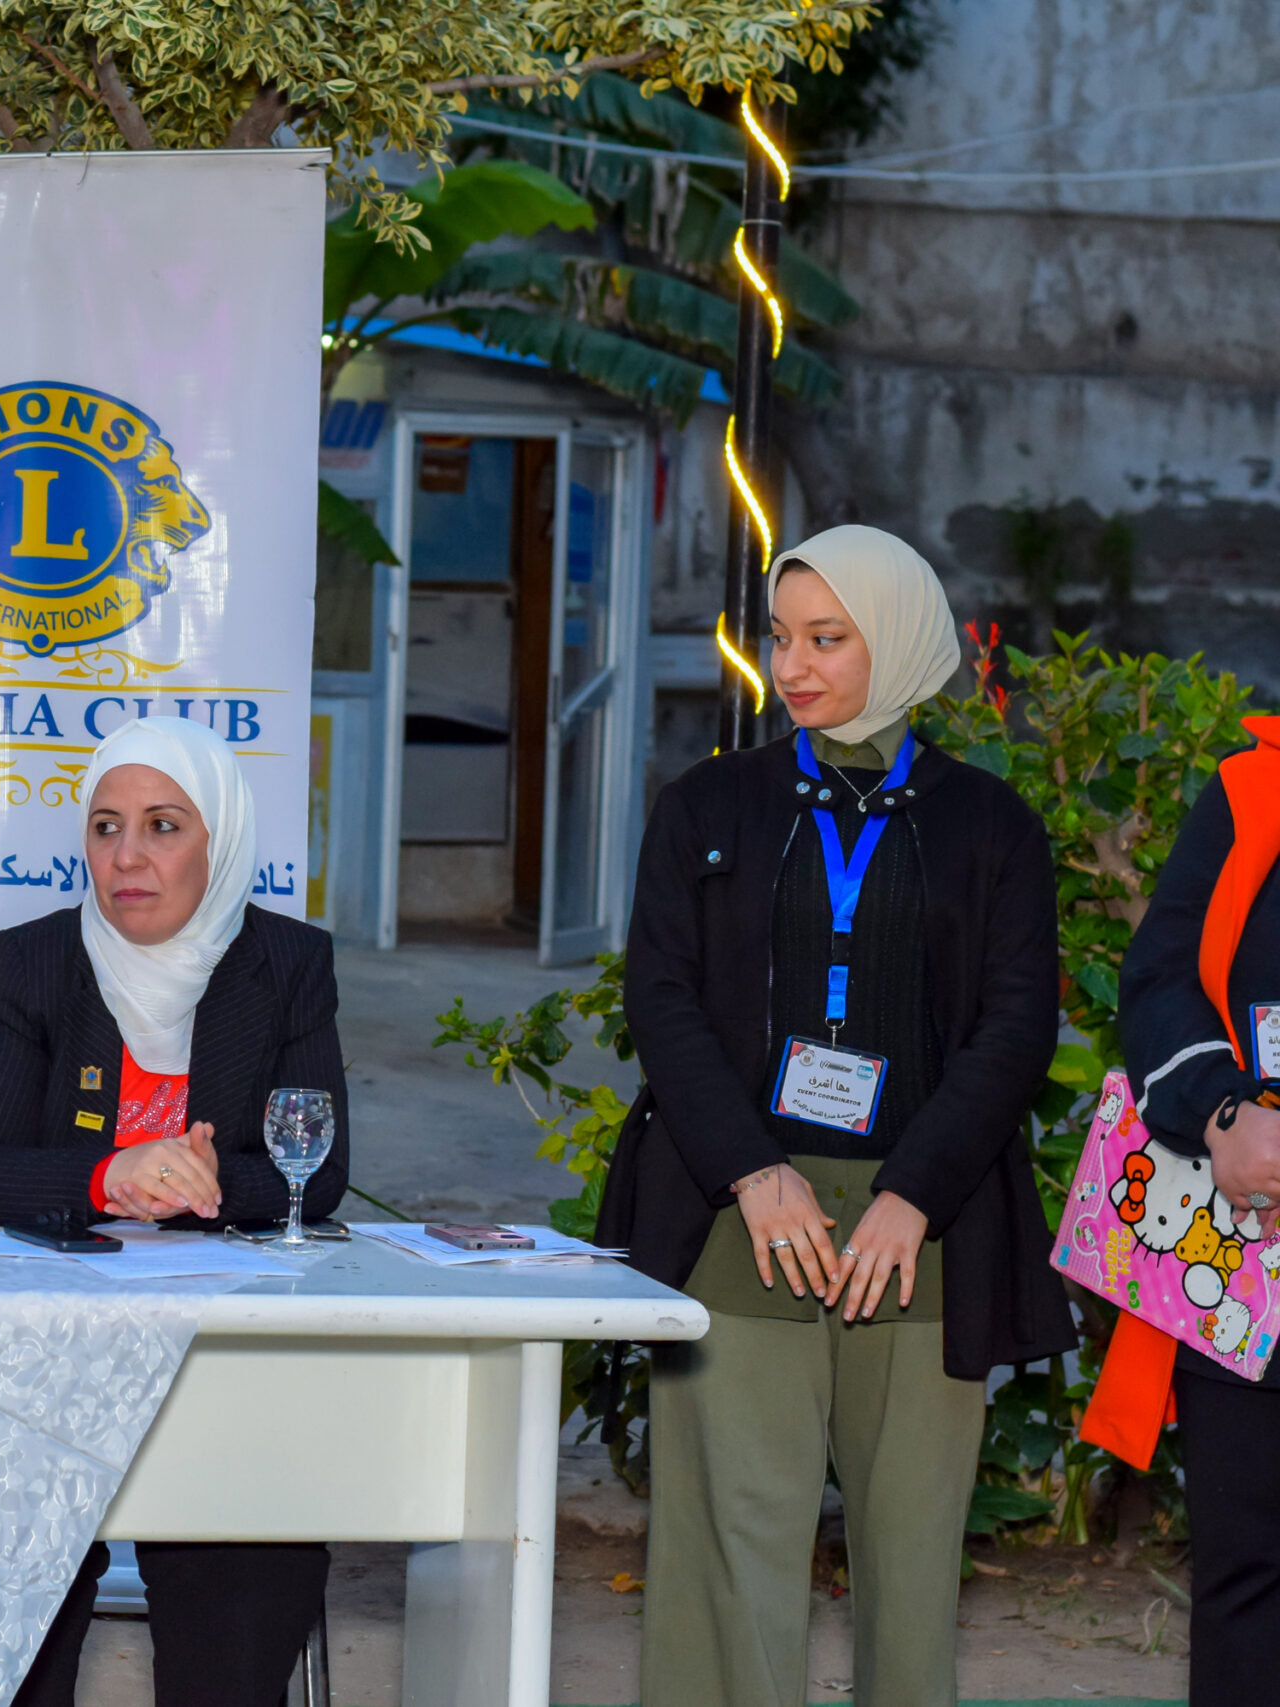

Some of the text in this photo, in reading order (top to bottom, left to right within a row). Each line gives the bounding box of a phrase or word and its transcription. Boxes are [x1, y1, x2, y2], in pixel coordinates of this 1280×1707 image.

[10, 469, 89, 560] L
[251, 861, 294, 896] ناد
[818, 1092, 862, 1106] COORDINATOR
[1104, 1226, 1119, 1294] Hello
